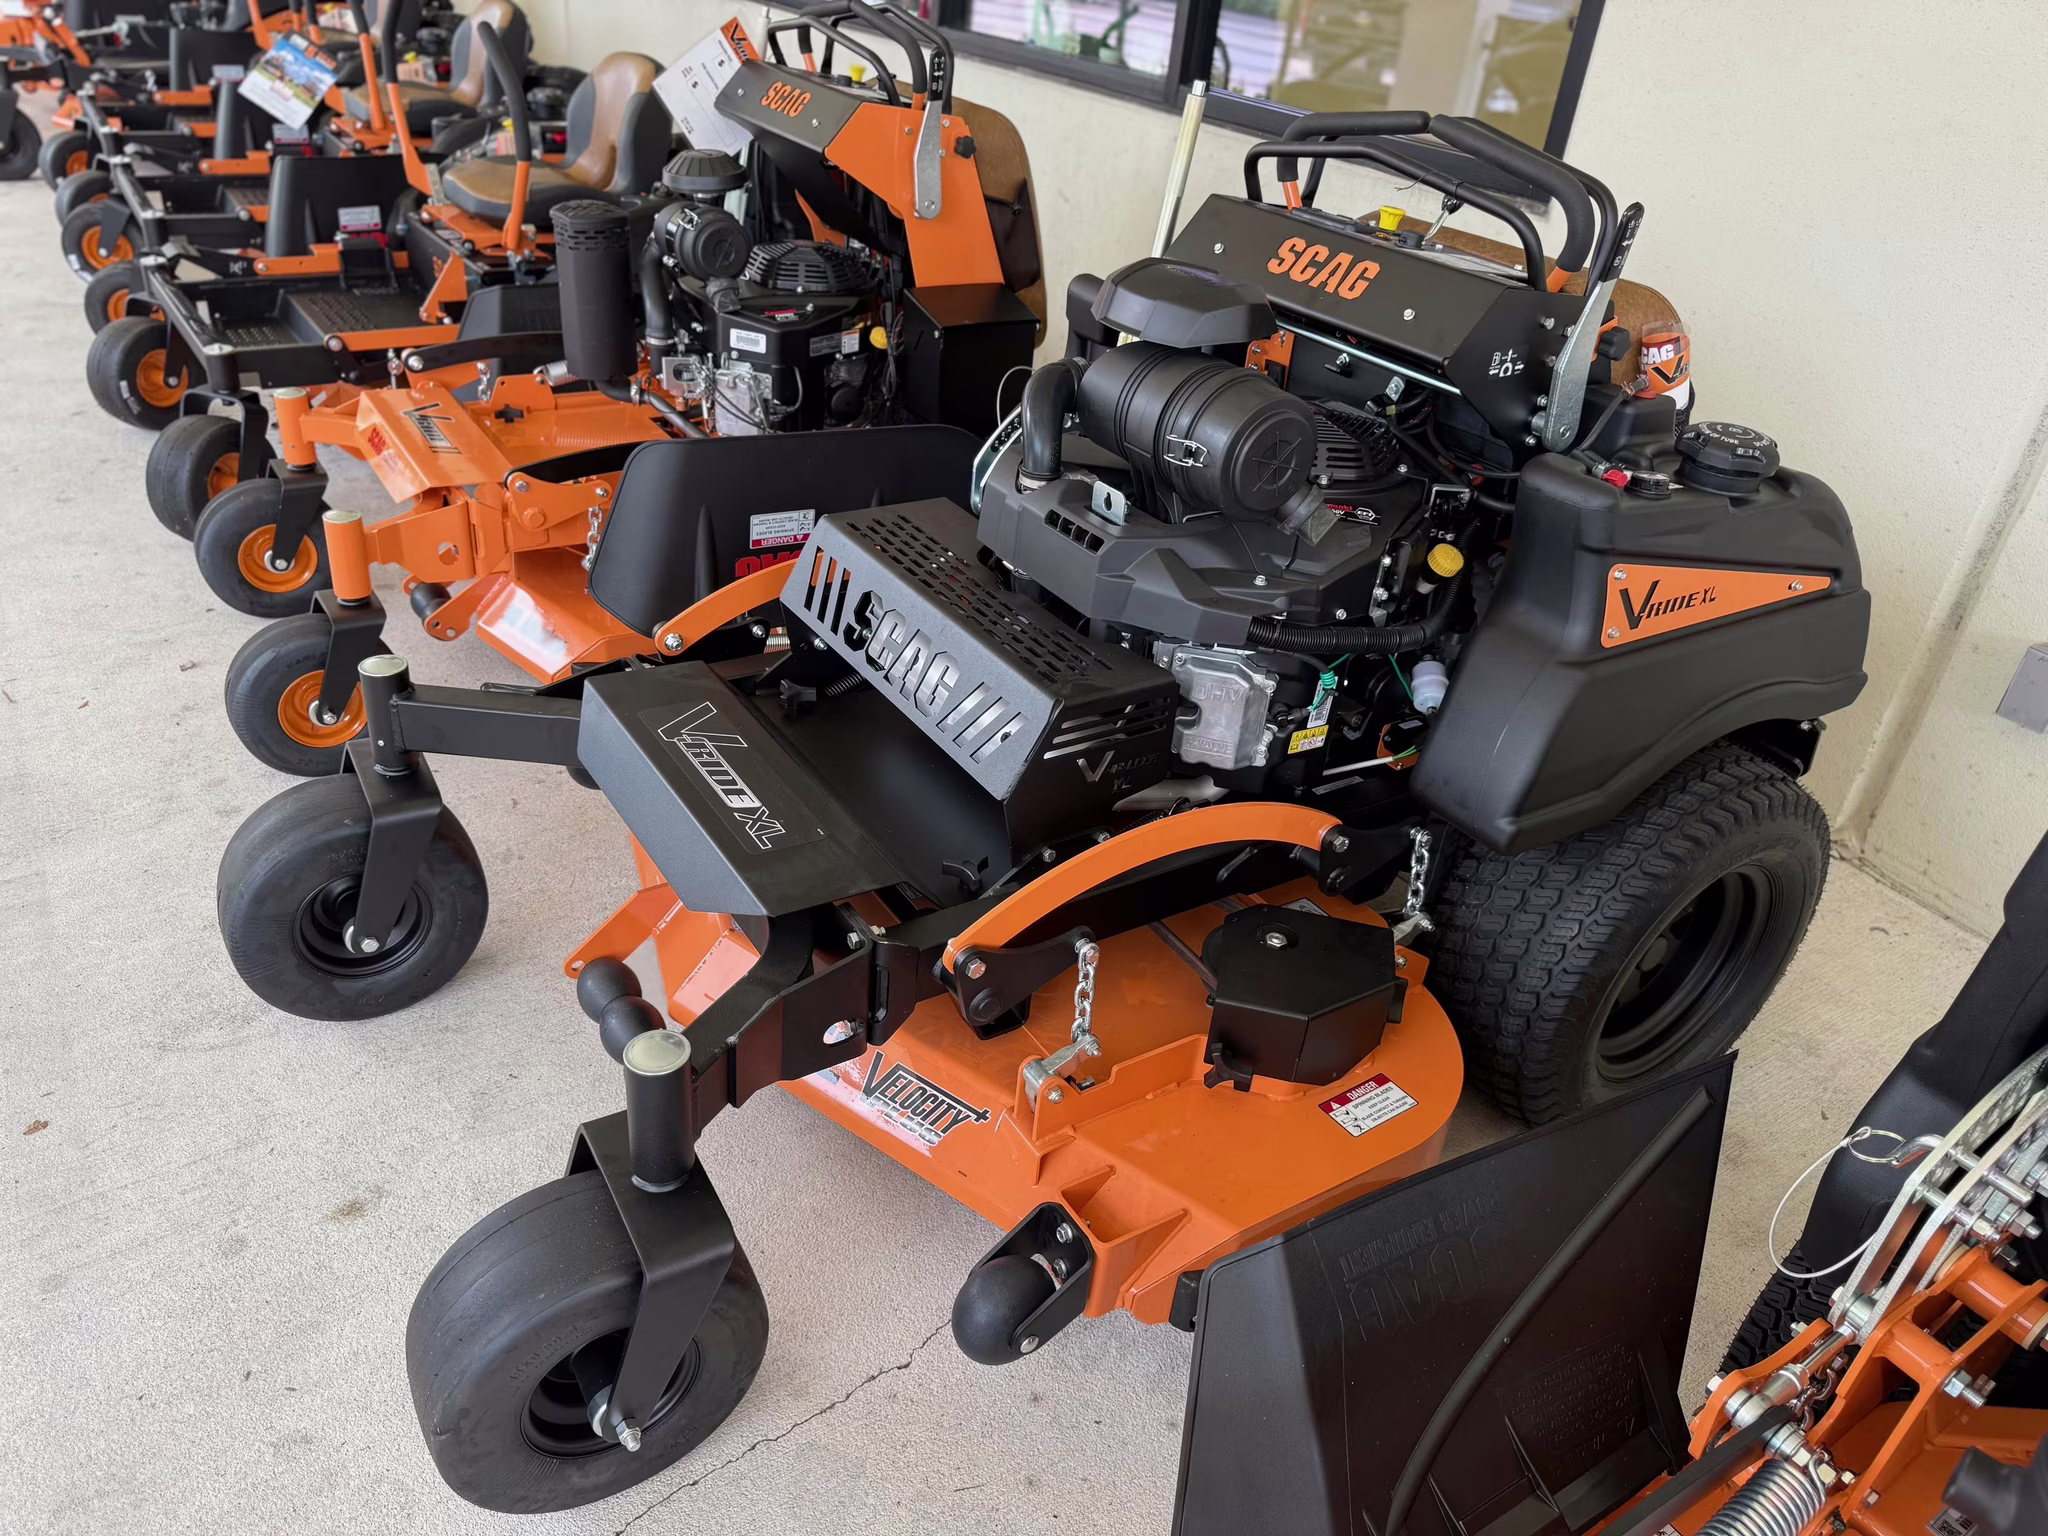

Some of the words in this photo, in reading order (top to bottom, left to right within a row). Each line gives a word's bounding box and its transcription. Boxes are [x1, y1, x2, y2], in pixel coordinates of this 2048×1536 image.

[760, 81, 812, 118] SCAG
[1267, 236, 1381, 300] SCAG
[1641, 343, 1675, 365] CAG
[1720, 436, 1740, 445] TUBE
[761, 536, 794, 545] DANGER
[1700, 586, 1717, 606] XL
[843, 590, 961, 718] SCAG
[1192, 682, 1244, 705] OHV
[733, 806, 786, 849] XL
[1346, 1081, 1379, 1100] DANGER
[1352, 1095, 1376, 1109] SPINNING
[1374, 1086, 1394, 1097] BLADES
